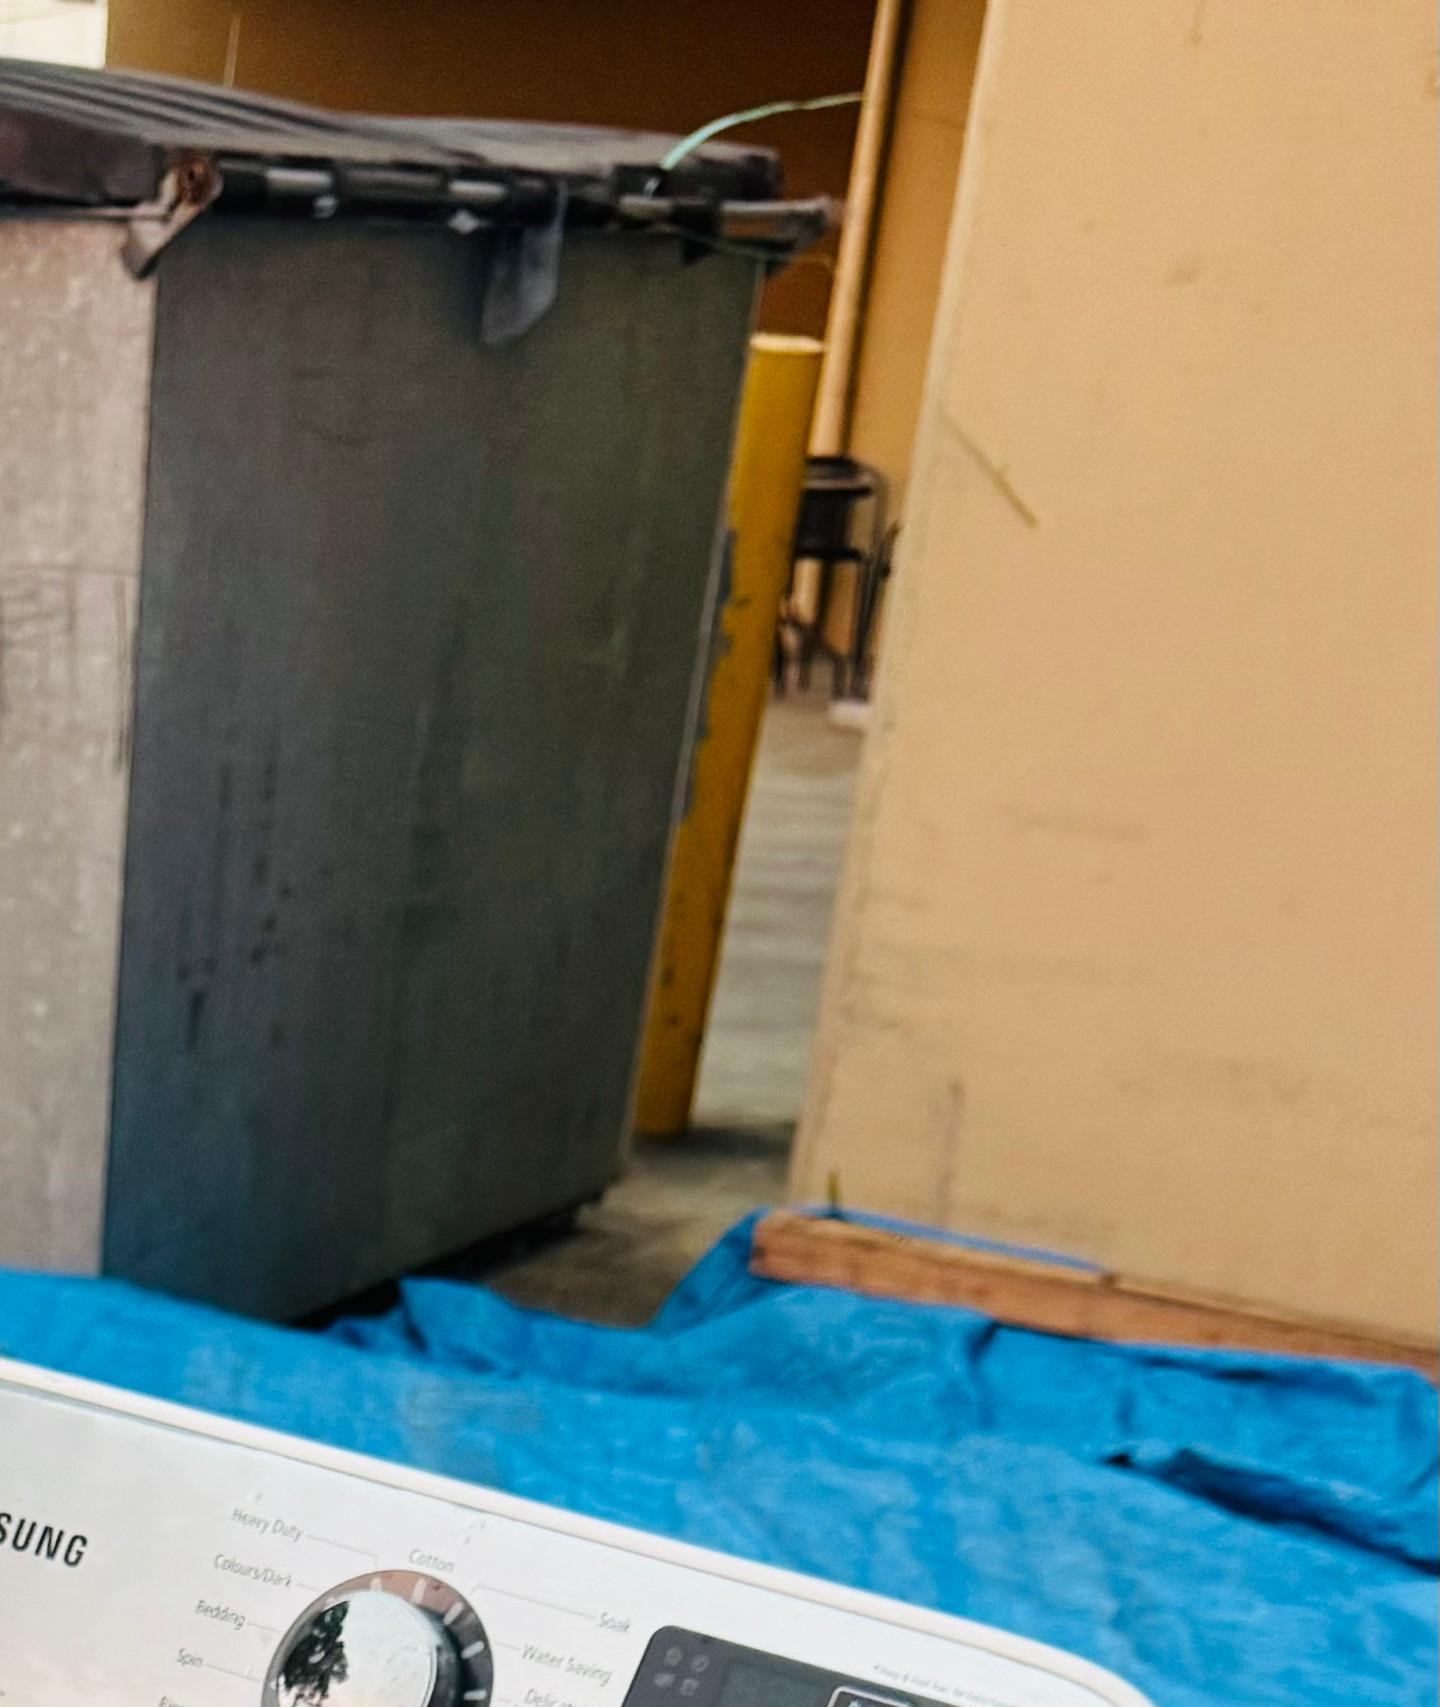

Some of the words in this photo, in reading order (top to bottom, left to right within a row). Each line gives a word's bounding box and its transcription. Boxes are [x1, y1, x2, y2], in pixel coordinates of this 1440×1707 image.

[232, 1507, 270, 1535] Heavy
[271, 1518, 304, 1544] Duty
[213, 1553, 293, 1588] Colours/Dark
[409, 1549, 456, 1575] Cotton
[195, 1599, 247, 1631] Bedding
[598, 1612, 631, 1633] Soak
[176, 1648, 204, 1668] Spin
[521, 1643, 562, 1671] Water
[564, 1657, 613, 1687] Saving
